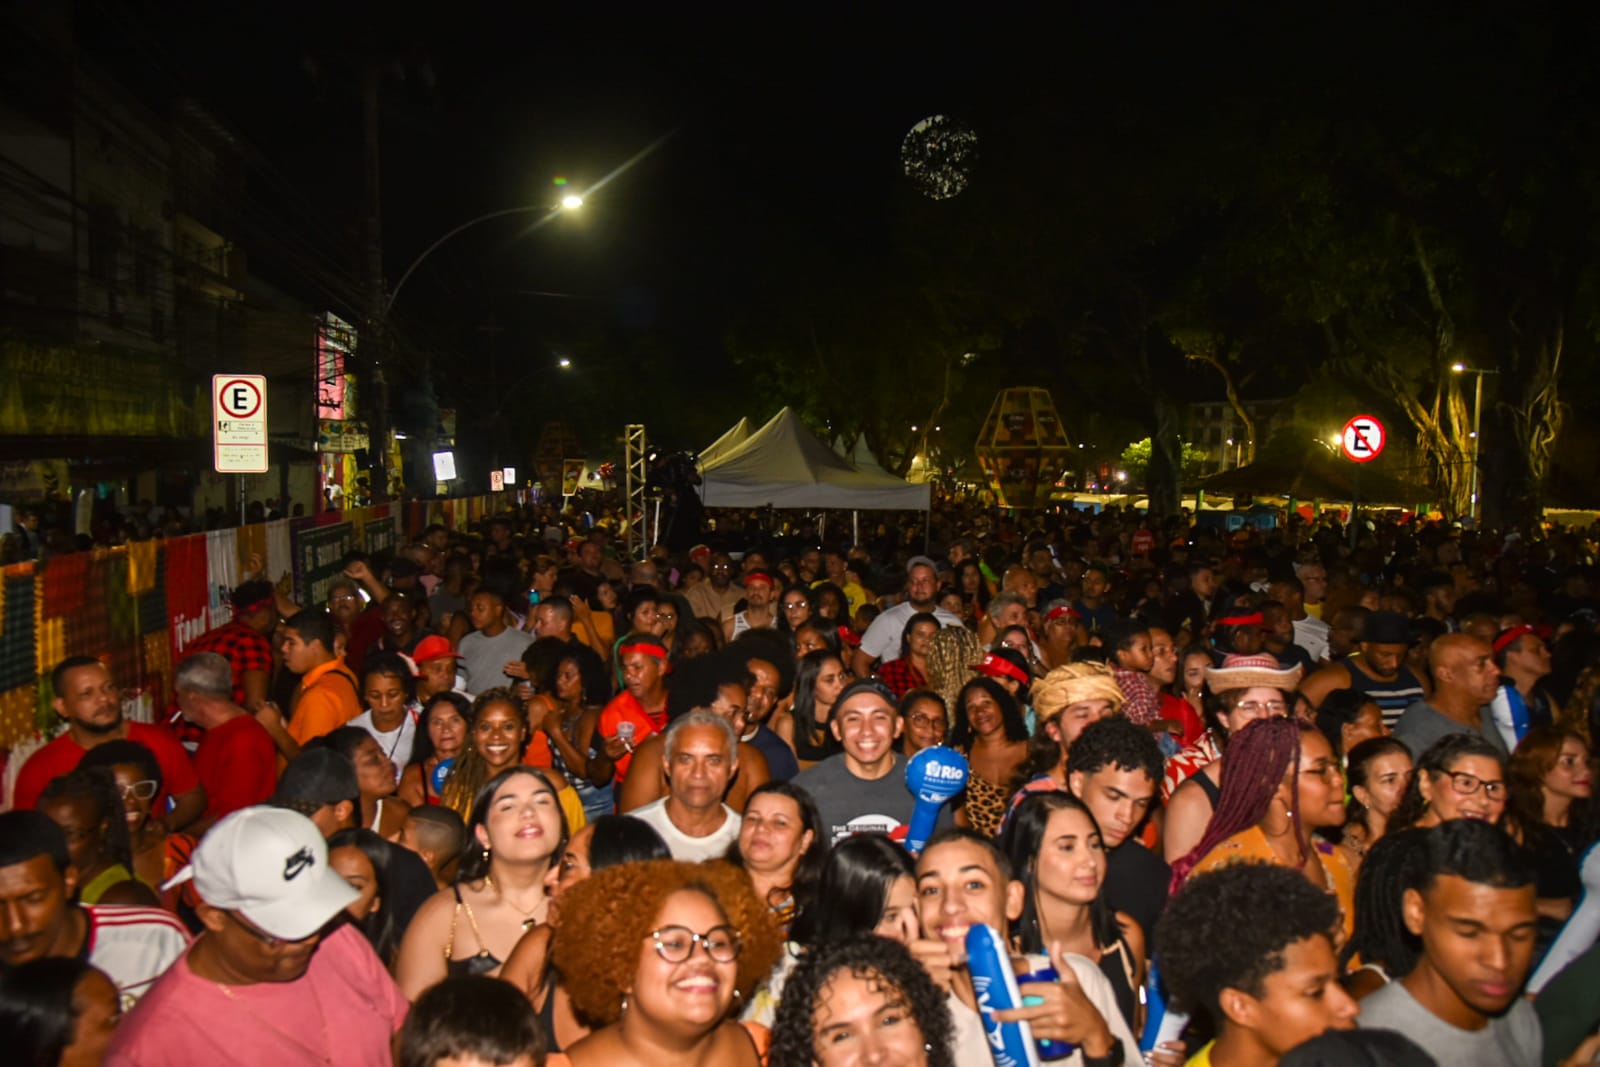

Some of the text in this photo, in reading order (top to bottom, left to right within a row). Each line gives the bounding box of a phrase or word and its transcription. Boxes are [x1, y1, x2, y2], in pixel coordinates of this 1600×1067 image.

[233, 388, 247, 410] E
[1353, 425, 1371, 451] E
[941, 765, 964, 780] Rio
